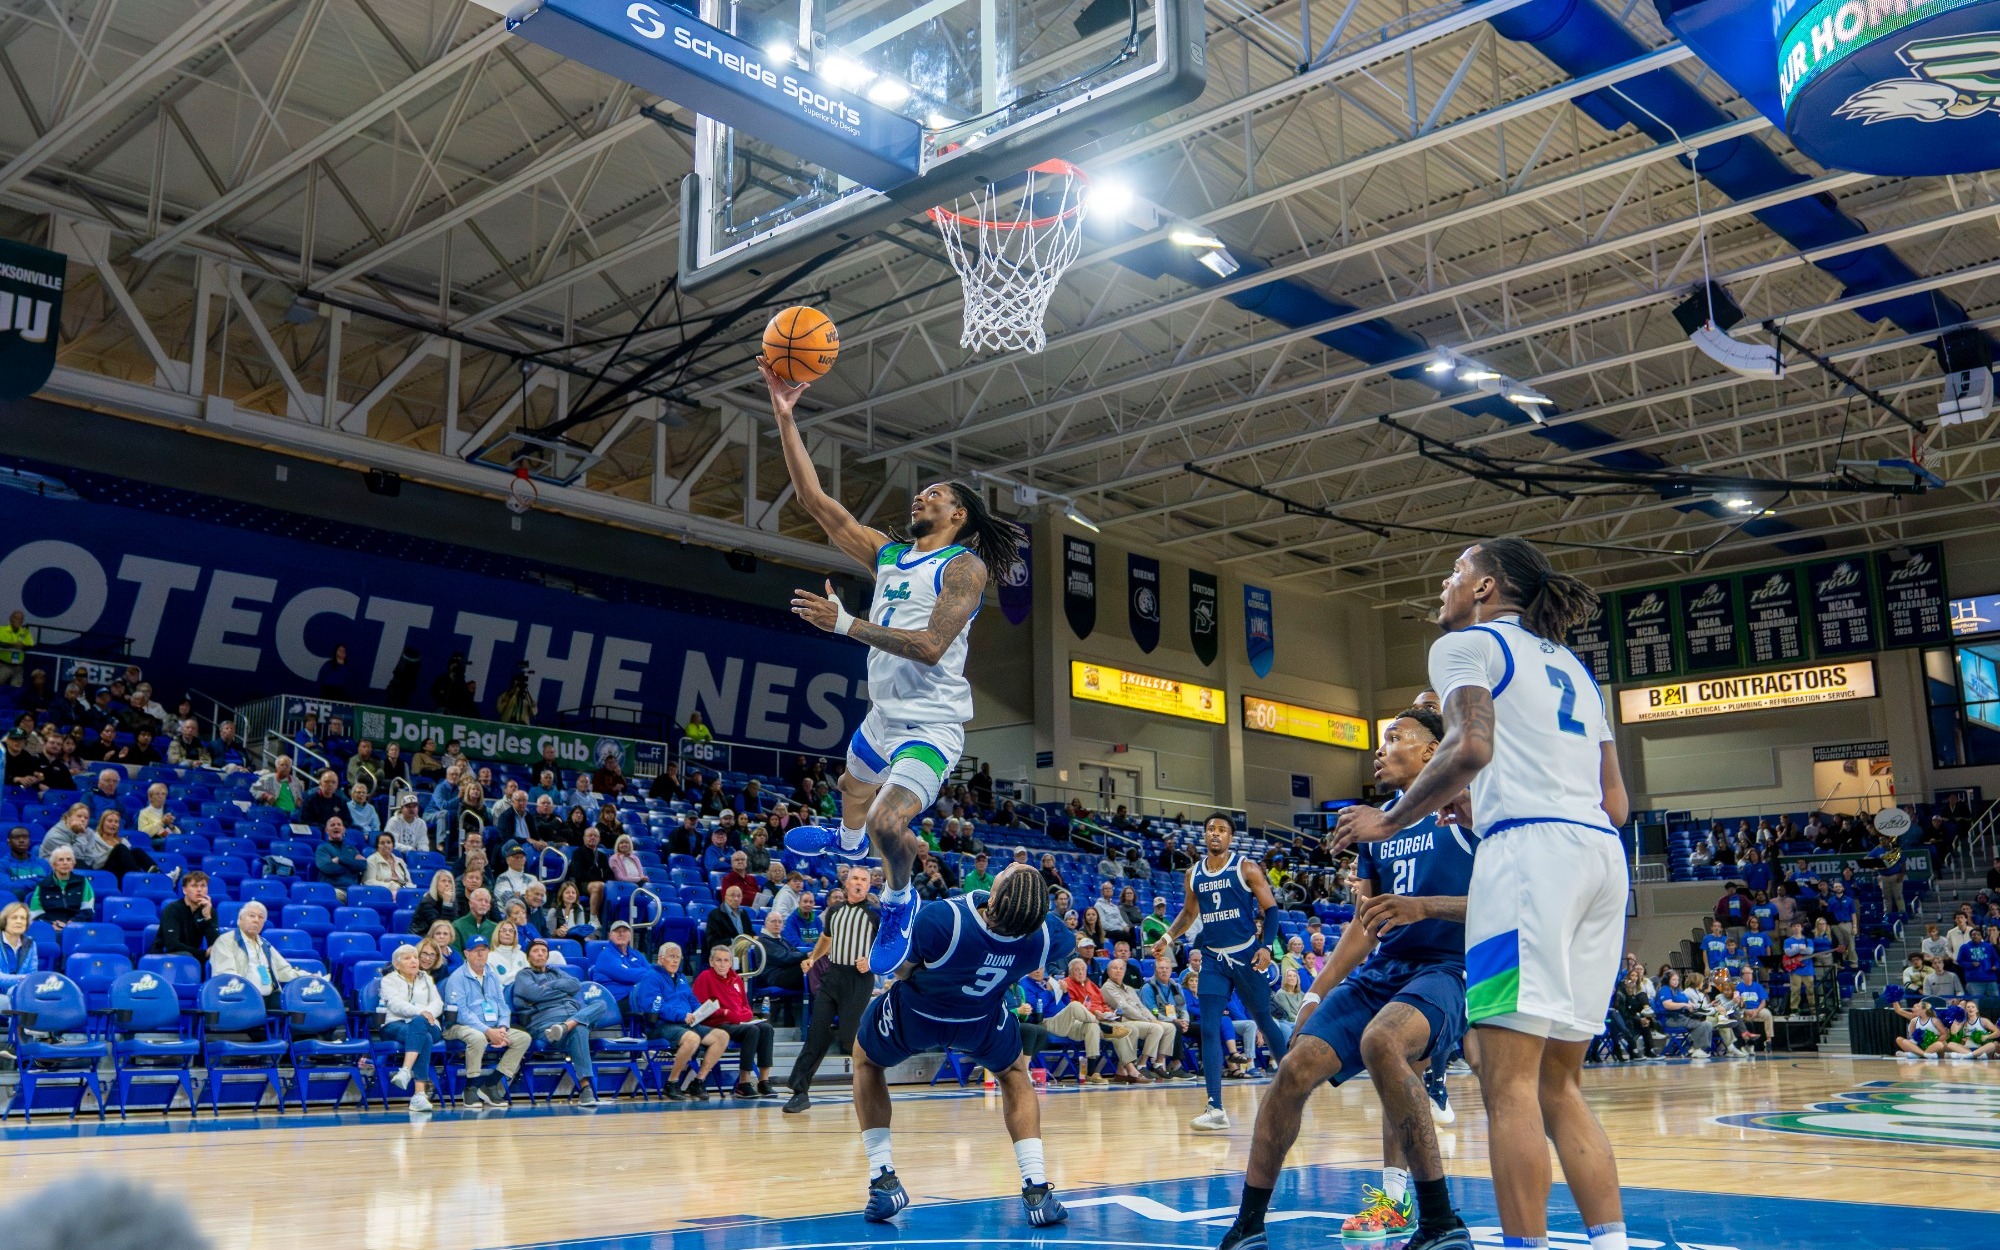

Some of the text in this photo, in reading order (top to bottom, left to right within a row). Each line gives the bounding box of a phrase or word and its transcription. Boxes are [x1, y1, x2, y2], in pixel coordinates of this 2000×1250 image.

[674, 26, 860, 126] Schelde Sports
[1780, 41, 1808, 110] OUR
[803, 104, 860, 137] Superior by Design
[0, 264, 62, 291] KSONVILLE
[1068, 550, 1092, 566] FLORIDA
[1133, 568, 1155, 582] QUEENS
[1889, 562, 1932, 583] FGCU
[1817, 571, 1860, 594] FGCU
[1193, 583, 1215, 597] STETSON
[1251, 592, 1265, 602] WEST
[1750, 582, 1790, 602] FGCU
[1900, 588, 1927, 600] NCAA
[1248, 600, 1269, 612] GEORGIA
[1689, 592, 1726, 612] FGCU
[1828, 599, 1855, 612] NCAA
[1888, 597, 1941, 612] APPEARANCES
[1627, 601, 1665, 620] FGCU
[1760, 608, 1785, 620] NCAA
[1818, 607, 1867, 622] TOURNAMENT
[1697, 617, 1721, 629] NCAA
[1749, 616, 1798, 631] TOURNAMENT
[1849, 618, 1866, 627] 2021
[1921, 615, 1939, 624] 2017
[1636, 626, 1659, 638] NCAA
[1687, 625, 1733, 639] TOURNAMENT
[1823, 630, 1840, 638] 2022
[1922, 624, 1940, 633] 2021
[1960, 626, 1979, 634] System
[1577, 633, 1599, 645] NCAA
[1626, 634, 1671, 648] TOURNAMENT
[1824, 638, 1841, 646] 2024
[1570, 641, 1610, 653] OURNAMENT
[454, 611, 653, 724] THE
[676, 650, 870, 751] NES
[1120, 672, 1175, 692] SKILLETS
[1649, 667, 1847, 707] B&I CONTRACTORS
[1545, 664, 1588, 737] 2
[1639, 690, 1856, 721] MECHANICAL ELECTRICAL PLUMBING REFRIGERATION SERVICE
[306, 702, 333, 723] FF
[1257, 703, 1277, 729] 60
[1328, 719, 1361, 733] CROWTHER
[389, 716, 589, 762] Join Eagles Club
[651, 747, 662, 759] FF
[694, 743, 714, 760] GG
[1815, 751, 1865, 761] FOUNDATION
[1380, 832, 1434, 860] GEORGIA
[1393, 858, 1416, 895] 21
[1199, 879, 1232, 893] GEORGIA
[1212, 892, 1222, 910] 9
[1202, 908, 1240, 924] SOUTHERN
[983, 953, 1015, 967] DUNN
[35, 981, 65, 994] FGCU
[130, 979, 158, 993] FGCU
[961, 967, 1007, 997] 3
[219, 983, 246, 996] FGCU
[301, 984, 325, 996] FGCU
